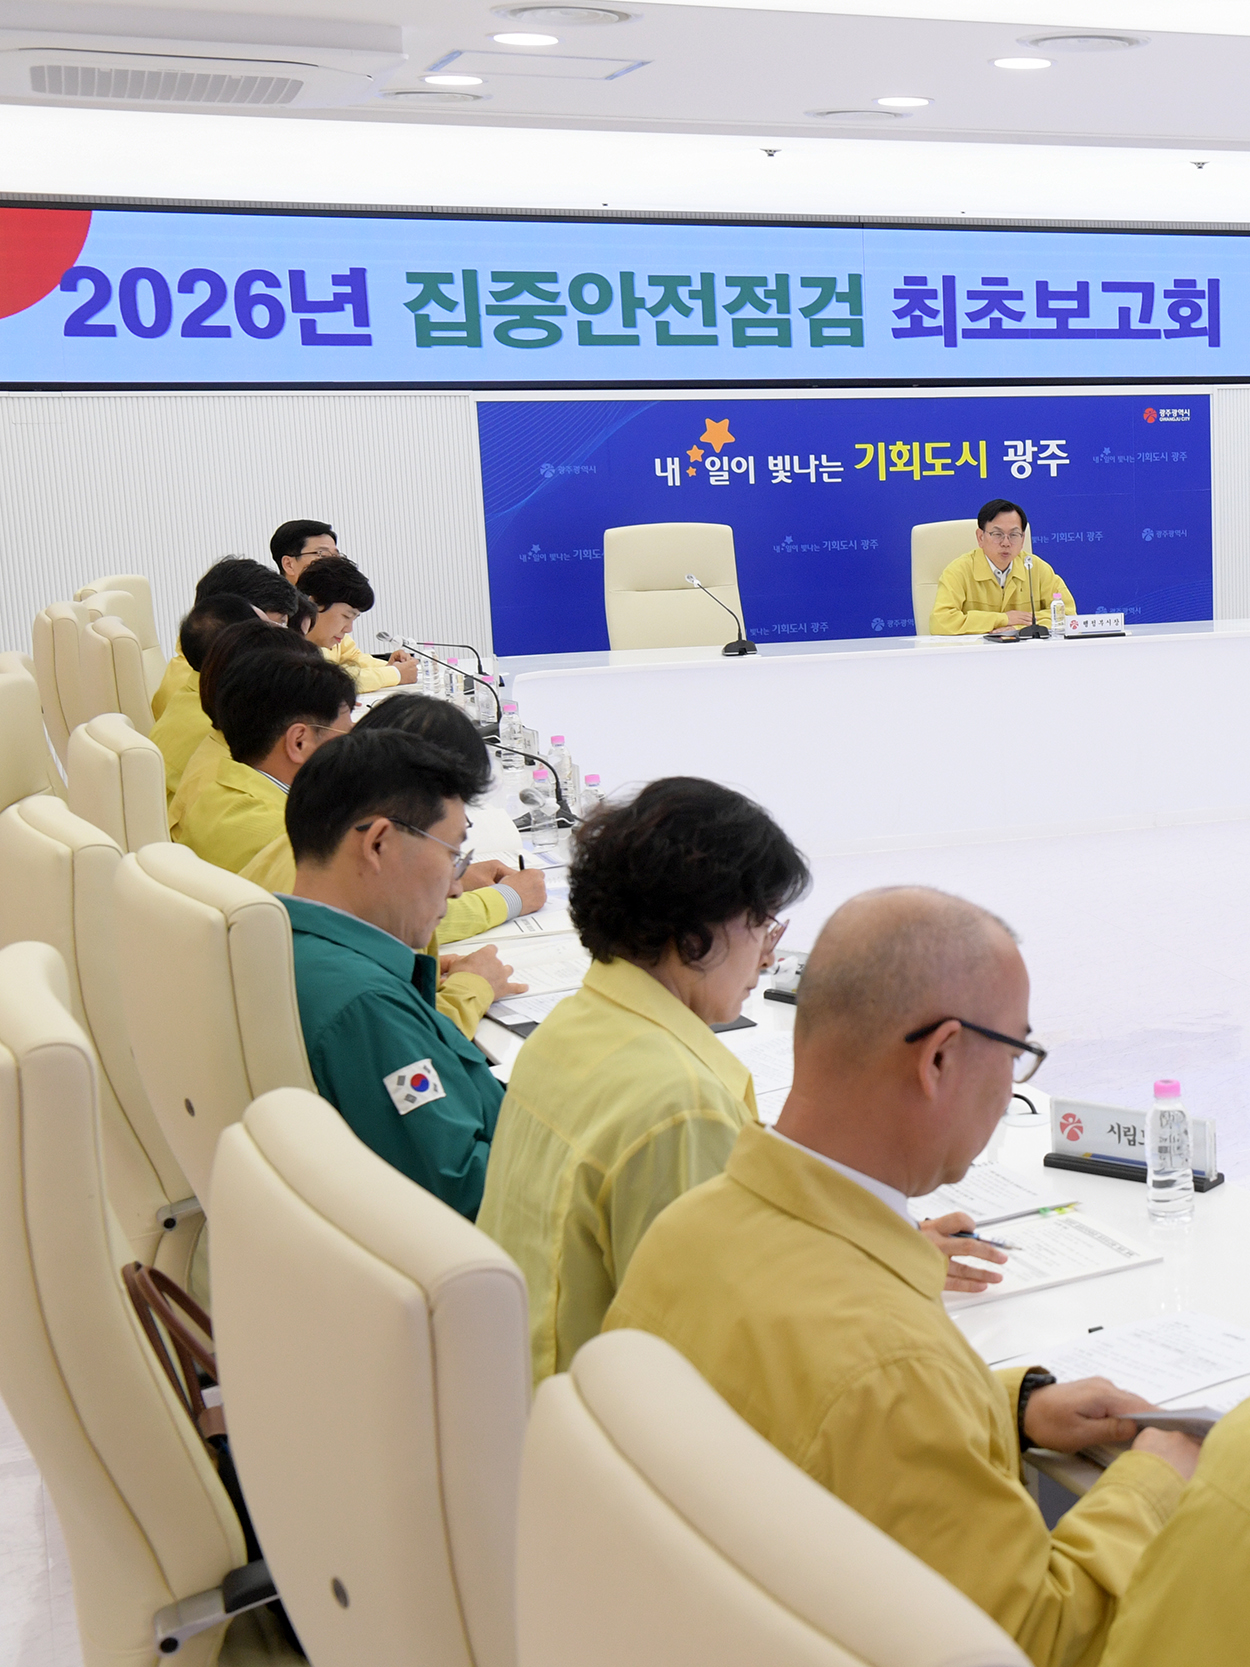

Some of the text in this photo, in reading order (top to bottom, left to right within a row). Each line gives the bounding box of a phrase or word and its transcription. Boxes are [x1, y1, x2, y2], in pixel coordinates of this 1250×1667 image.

[59, 266, 1221, 349] 2026년 집중안전점검 최초보고회
[1159, 408, 1191, 417] 광주광역시
[768, 454, 844, 484] 빛나는
[853, 440, 988, 482] 기회도시
[1002, 439, 1071, 479] 광주
[1136, 452, 1169, 463] 기회도시
[1171, 451, 1188, 461] 광주
[557, 465, 597, 475] 광주광역시
[1051, 532, 1084, 543] 기회도시
[1086, 531, 1104, 542] 광주
[1156, 529, 1188, 539] 광주광역시
[822, 540, 857, 551] 기회도시
[860, 539, 879, 550] 광주
[572, 549, 604, 561] 기회도
[771, 623, 807, 634] 기회도시
[810, 622, 829, 633] 광주
[887, 618, 915, 628] 광주광역
